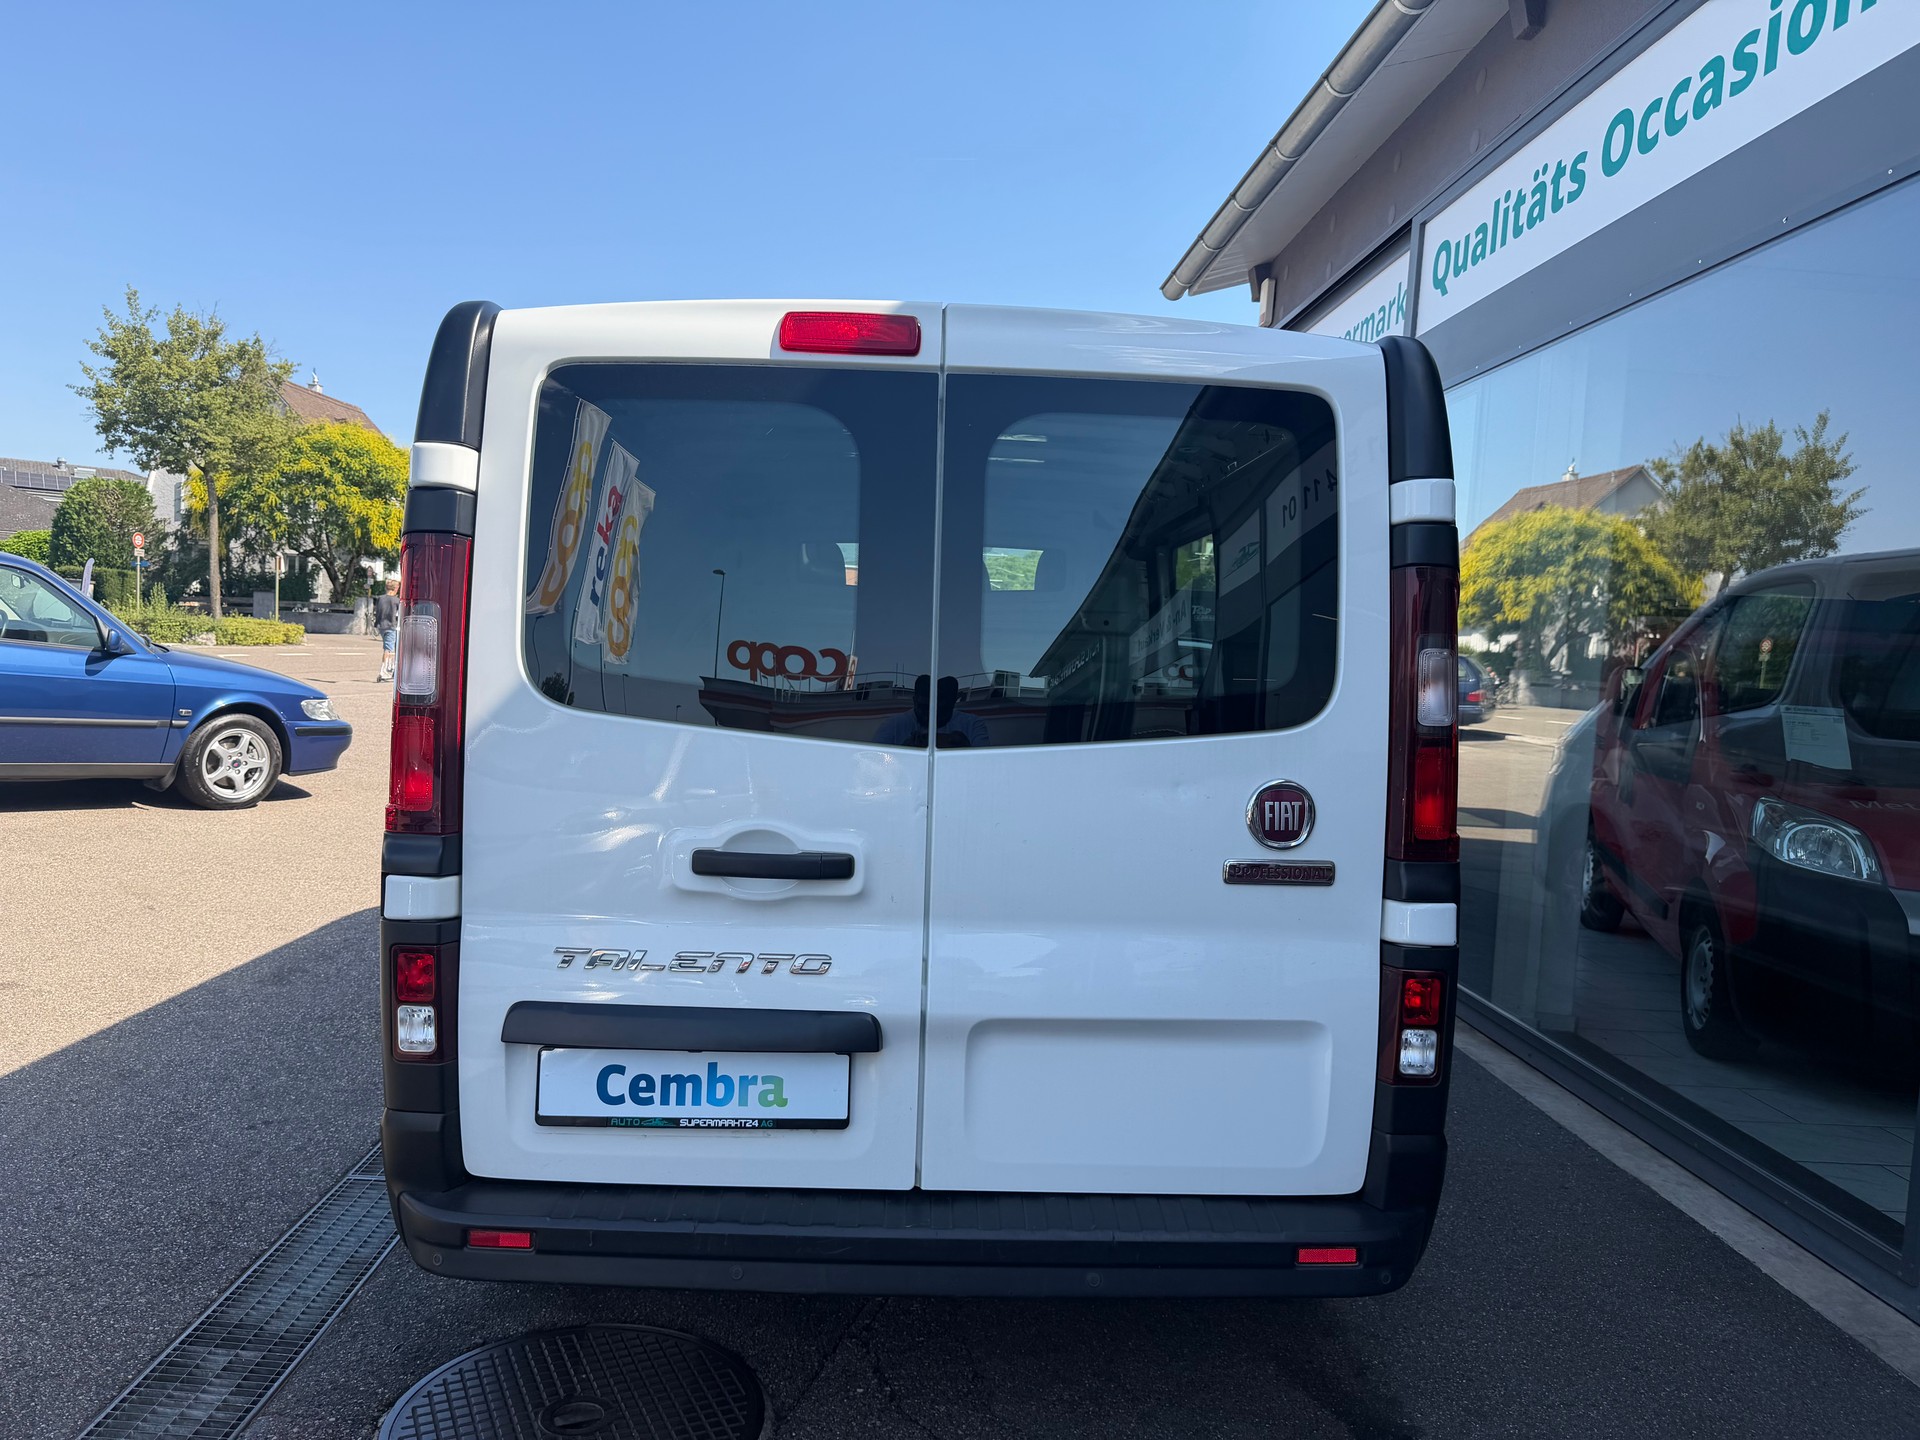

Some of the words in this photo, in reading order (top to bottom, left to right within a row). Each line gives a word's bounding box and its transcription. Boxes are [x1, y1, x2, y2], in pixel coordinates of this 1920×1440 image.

[1432, 151, 1588, 297] Qualitäts
[590, 485, 622, 607] reka
[1264, 801, 1303, 831] FIAT
[1232, 866, 1331, 881] PROFESSIONAL
[553, 946, 833, 975] TALENTO
[596, 1061, 789, 1108] Cembra
[611, 1118, 641, 1127] AUTO
[679, 1118, 760, 1128] SUPERMARKT24
[760, 1119, 774, 1128] AG
